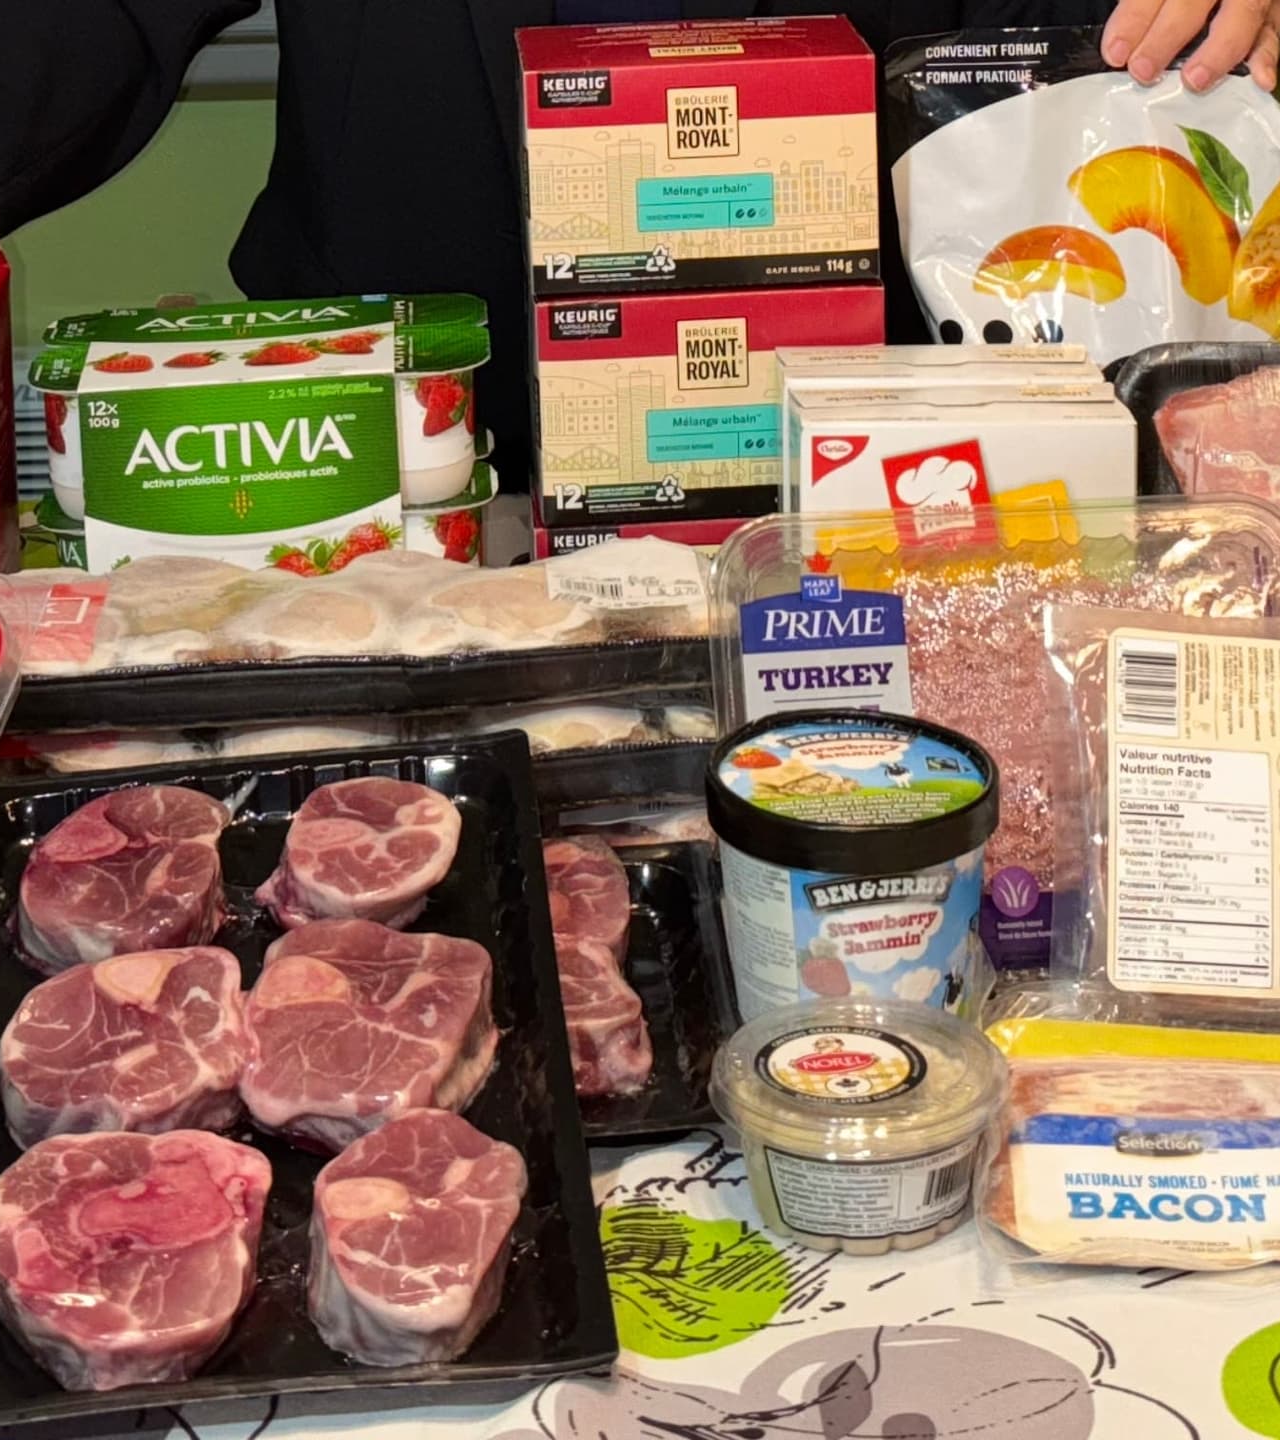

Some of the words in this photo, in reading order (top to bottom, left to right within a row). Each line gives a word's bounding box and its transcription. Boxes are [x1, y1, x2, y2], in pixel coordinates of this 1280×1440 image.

[926, 44, 998, 60] CONVENIENT
[1001, 41, 1048, 58] FORMAT
[543, 76, 606, 91] KEURIG
[926, 70, 971, 84] FORMAT
[974, 68, 1032, 84] PRATIQUE
[675, 93, 729, 105] BRÛLERIE
[676, 107, 733, 127] MONT-
[677, 129, 730, 149] ROYAL
[662, 182, 709, 197] Mélange
[712, 183, 748, 195] urbain
[543, 254, 573, 280] 12
[136, 304, 352, 331] ACTIVIA
[554, 310, 617, 323] KEURIG
[685, 326, 739, 337] BRÛLERIE
[686, 338, 743, 358] MONT-
[686, 360, 740, 380] ROYAL
[672, 414, 719, 428] Mélange
[722, 413, 757, 425] urbain
[125, 414, 354, 475] ACTIVIA
[142, 477, 174, 489] active
[176, 473, 230, 488] probiotics
[240, 469, 308, 484] probiotiques
[309, 465, 338, 476] actifs
[554, 484, 584, 510] 12
[803, 578, 836, 589] MAPLE
[808, 587, 832, 597] LEAF
[762, 606, 886, 641] PRIME
[758, 662, 893, 692] TURKEY
[1120, 749, 1159, 760] Valeur
[1162, 752, 1213, 765] nutritive
[1120, 764, 1174, 776] Nutrition
[1177, 766, 1212, 779] Facts
[1120, 801, 1160, 812] Calories
[827, 910, 939, 938] Strawberry
[844, 929, 926, 955] Jammin'
[803, 1055, 864, 1071] NOREL
[1119, 1134, 1200, 1152] Selection
[1064, 1173, 1143, 1189] NATURALLY
[1148, 1175, 1207, 1189] SMOKED
[1067, 1192, 1267, 1223] BACON
